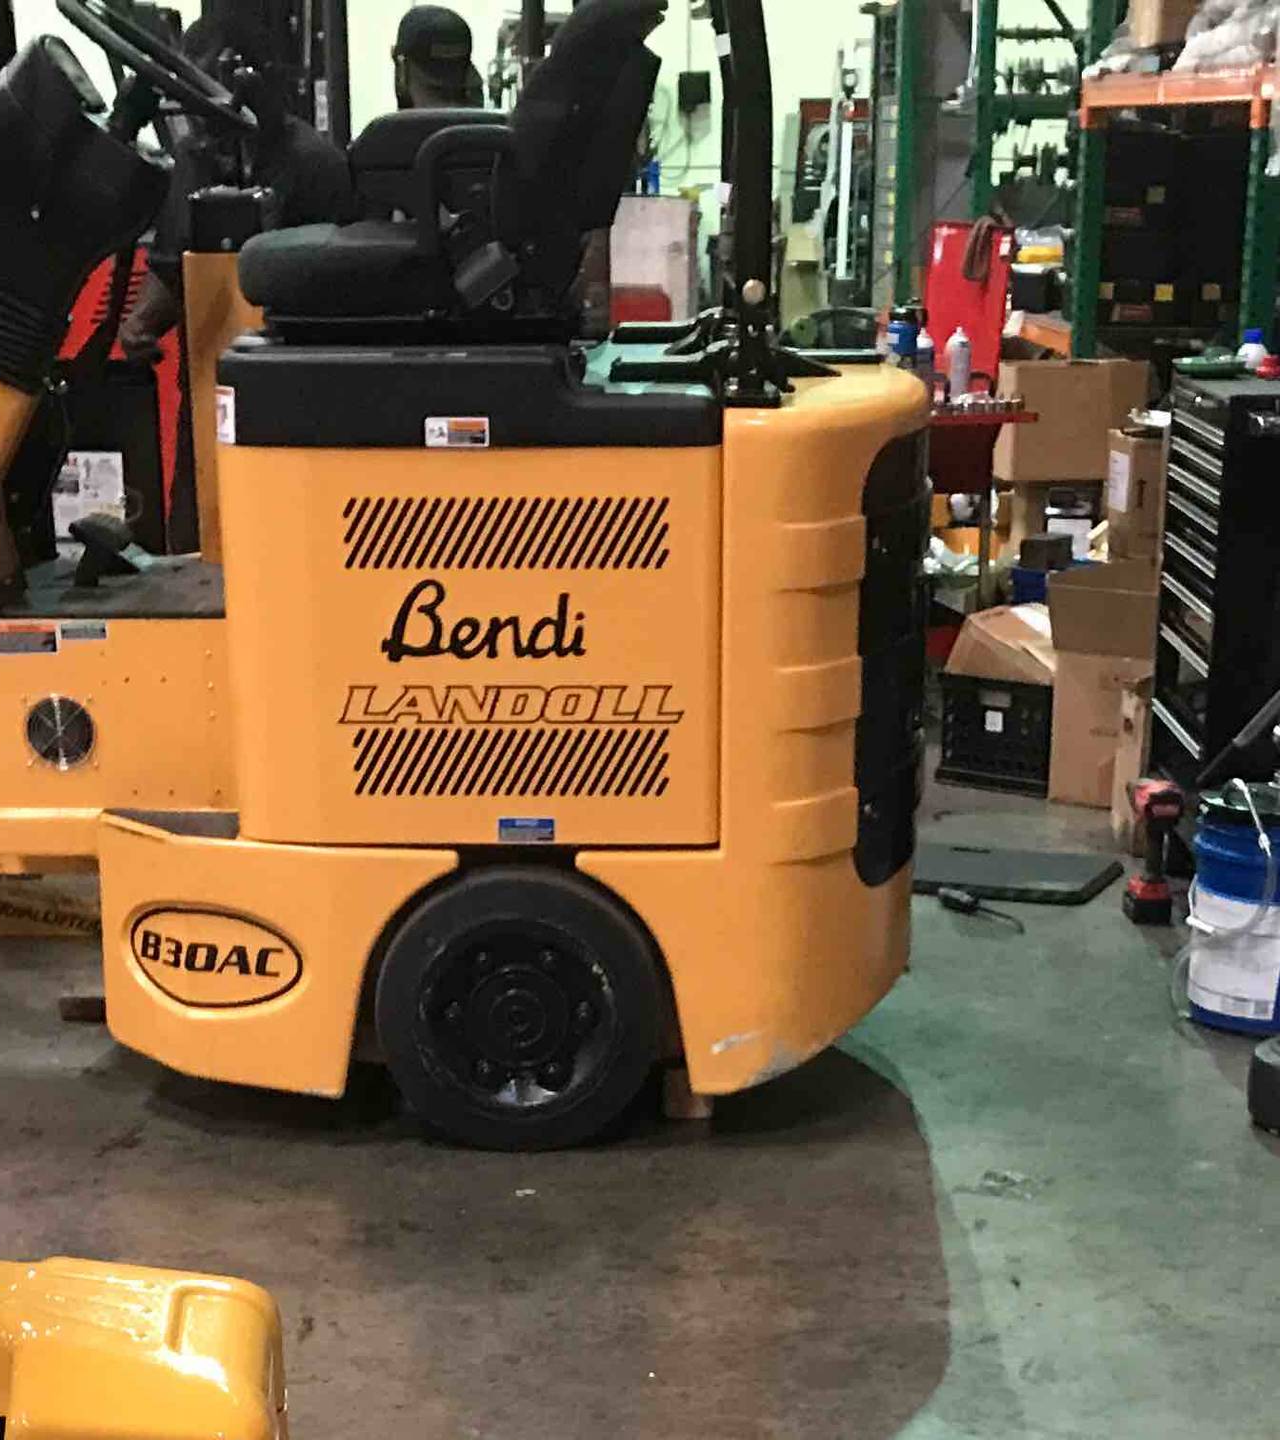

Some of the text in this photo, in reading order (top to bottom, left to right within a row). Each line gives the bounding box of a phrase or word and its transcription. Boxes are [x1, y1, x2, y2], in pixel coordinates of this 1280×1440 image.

[381, 579, 586, 662] Bendi
[338, 684, 685, 725] LANDOLL
[140, 929, 284, 978] B30AC
